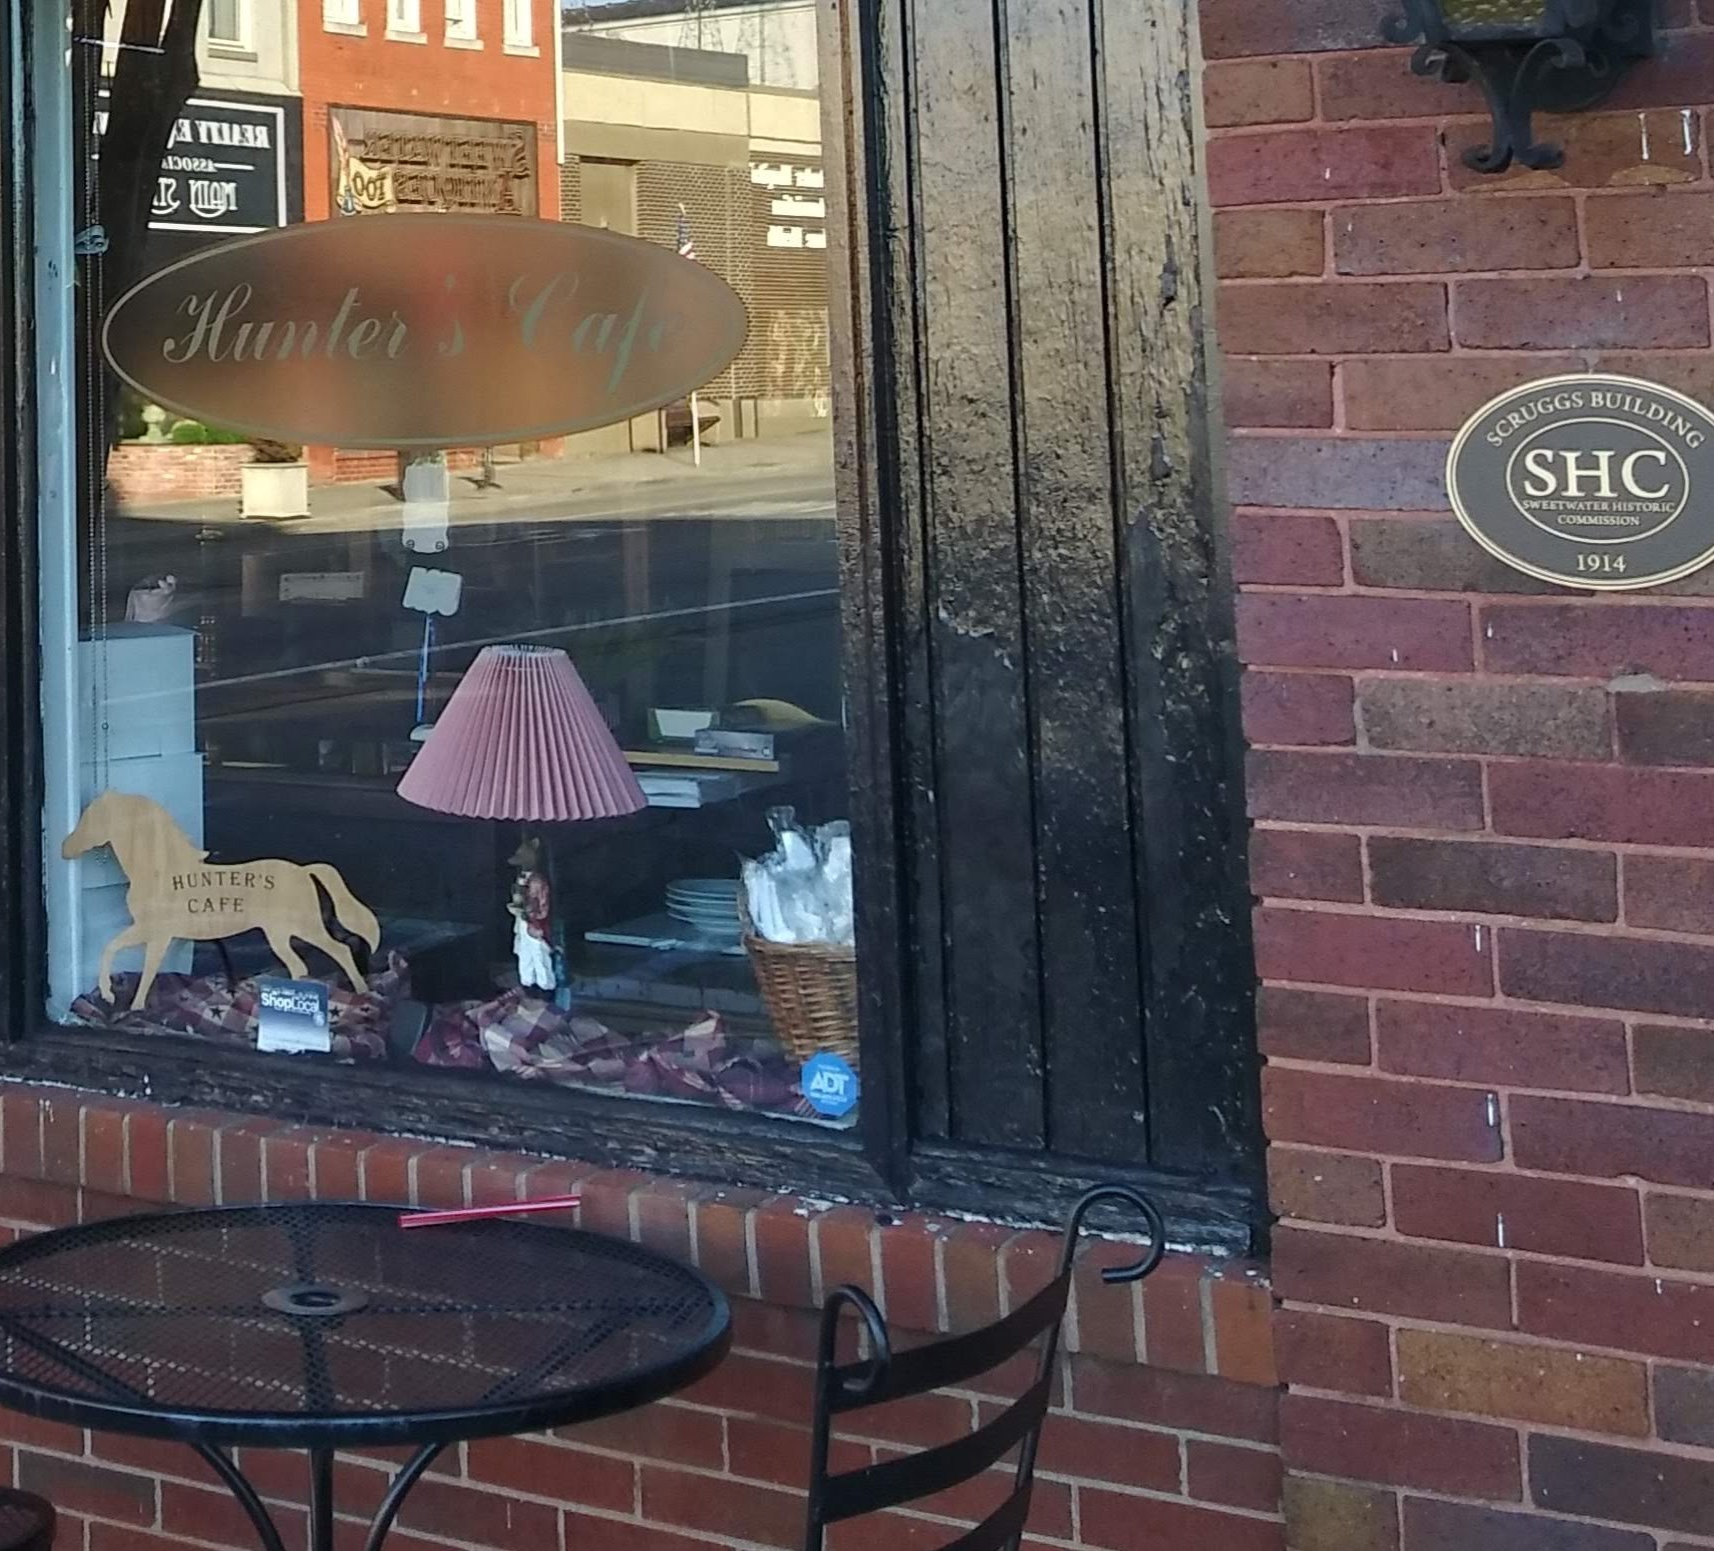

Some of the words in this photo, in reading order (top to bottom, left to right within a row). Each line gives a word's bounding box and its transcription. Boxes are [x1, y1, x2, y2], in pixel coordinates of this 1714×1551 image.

[162, 272, 466, 363] Hunter's
[1487, 392, 1584, 447] SCRUGGS
[1590, 392, 1706, 449] BUILDING
[1523, 449, 1670, 498] SHC
[1522, 500, 1609, 512] SWEETWATER
[1612, 501, 1676, 513] HISTORIC
[1557, 515, 1640, 526] COMMISSION
[1576, 554, 1627, 573] 1914
[172, 870, 275, 891] HUNTER'S
[187, 897, 245, 914] CAFE
[810, 1071, 849, 1095] ADT
